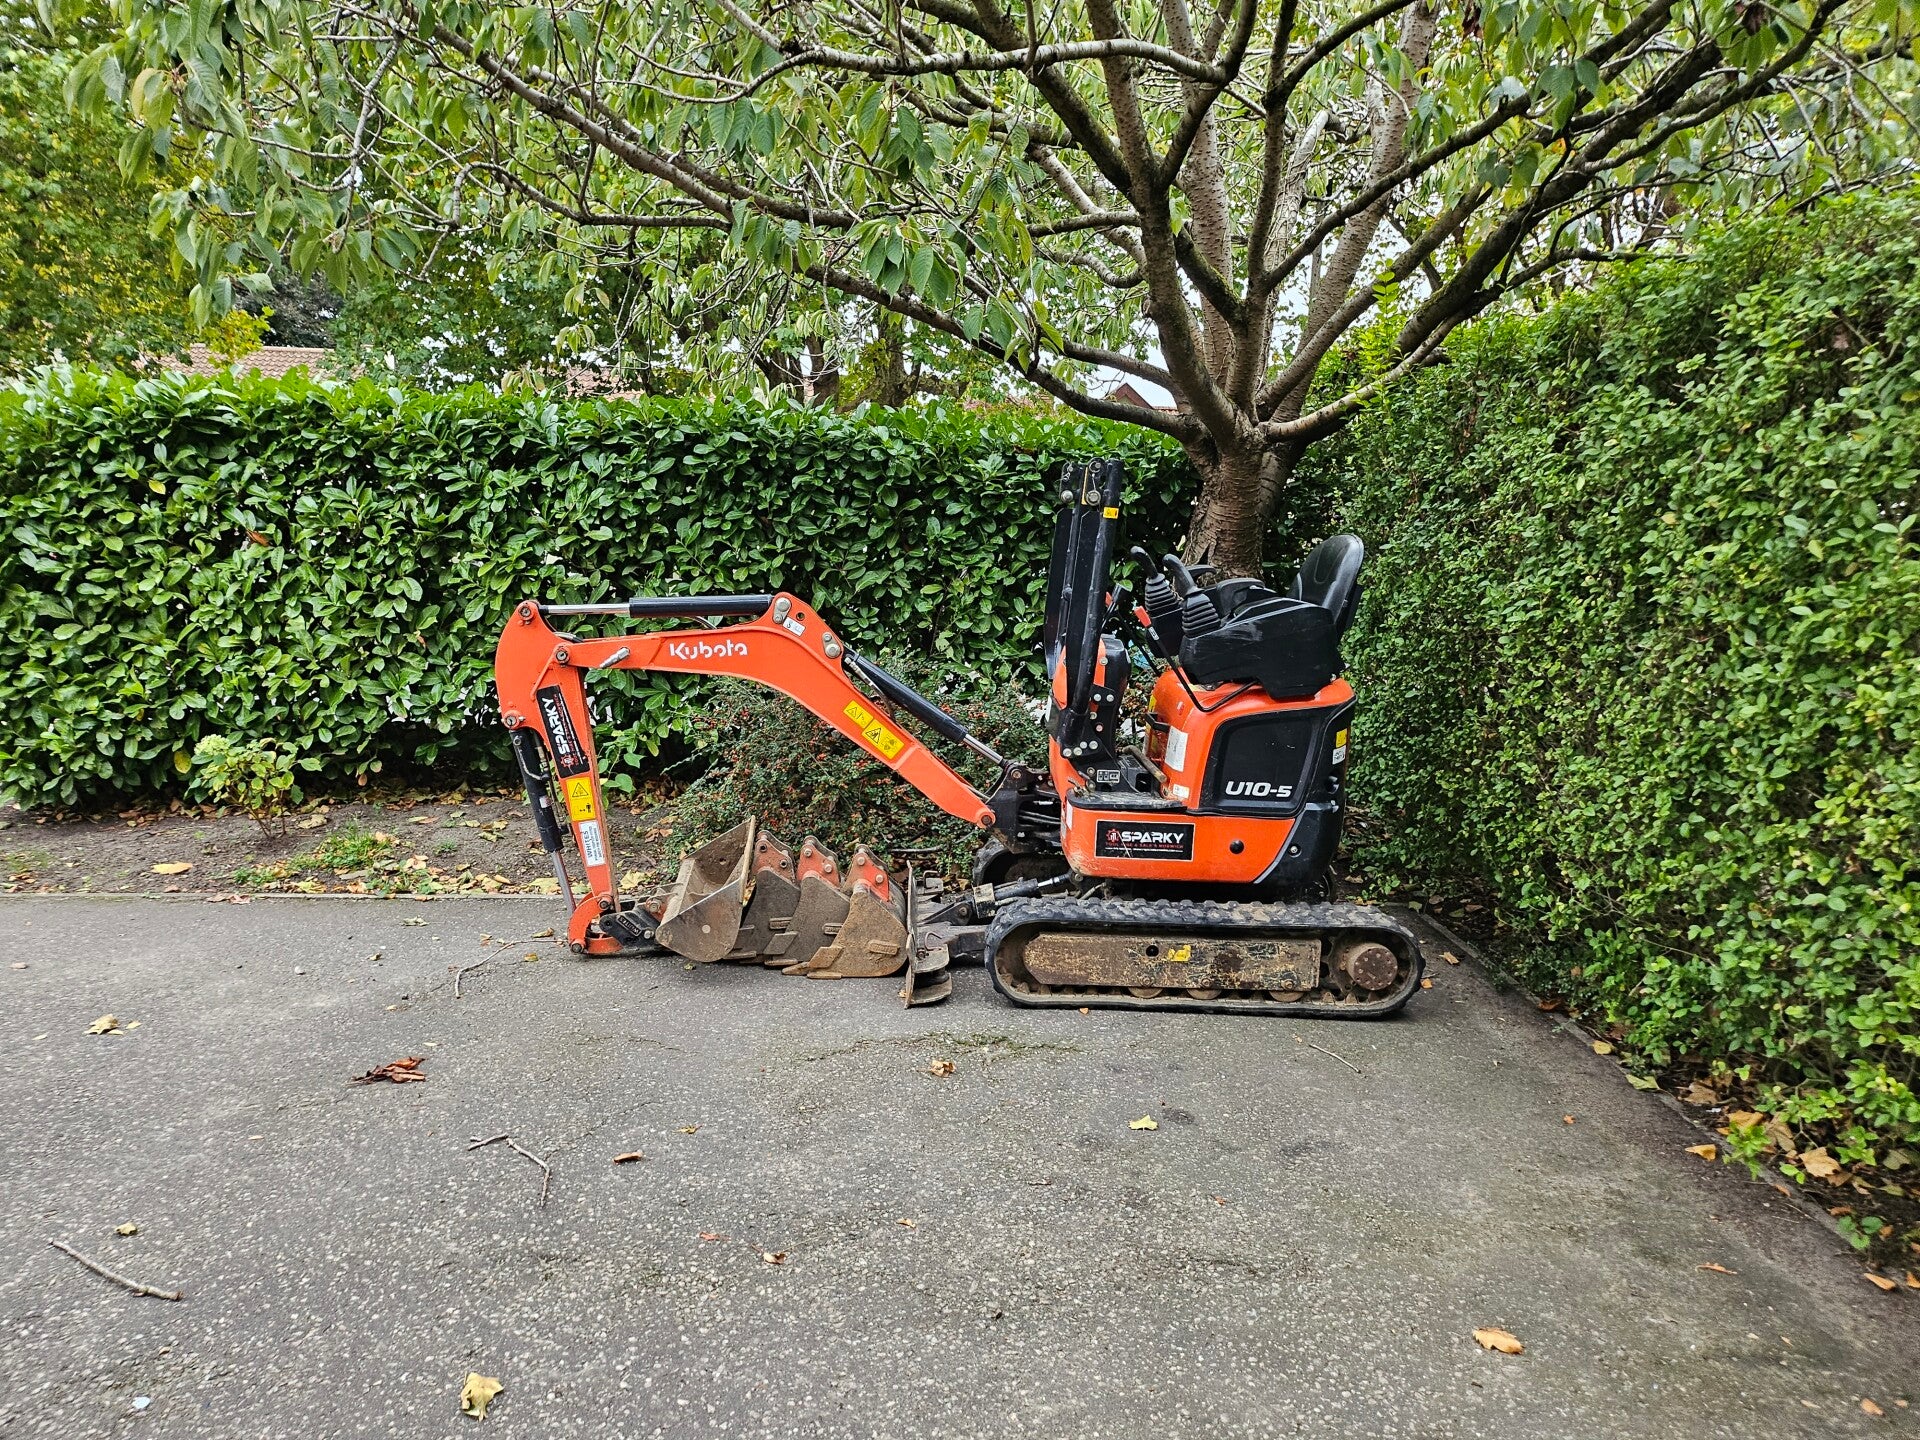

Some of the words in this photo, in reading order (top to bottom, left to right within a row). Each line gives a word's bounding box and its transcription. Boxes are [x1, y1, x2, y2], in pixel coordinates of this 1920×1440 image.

[669, 639, 748, 660] Kubota
[541, 697, 570, 755] SPARKY
[1225, 781, 1293, 798] U10-5
[583, 831, 593, 858] WHITES
[1121, 831, 1184, 844] SPARKY
